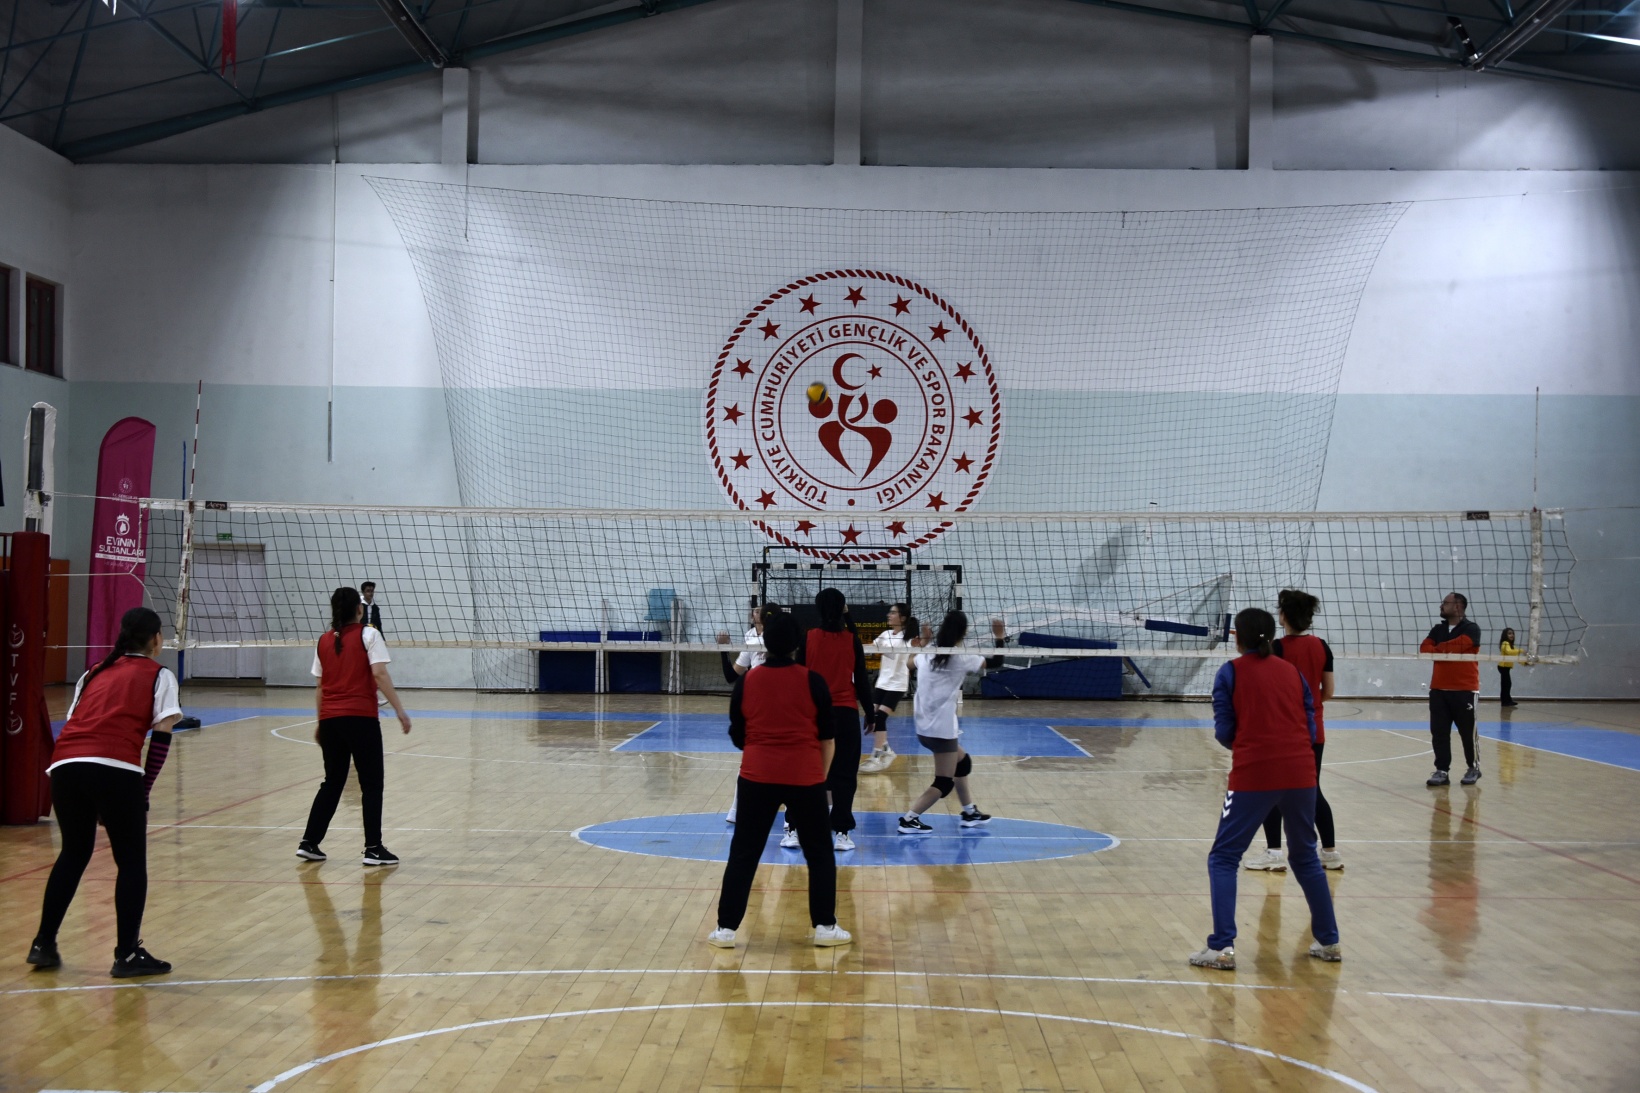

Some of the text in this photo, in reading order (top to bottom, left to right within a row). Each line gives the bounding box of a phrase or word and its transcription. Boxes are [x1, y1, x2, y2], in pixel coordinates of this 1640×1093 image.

[760, 323, 947, 505] TÜRKİYE CUMHURİYETİ GENÇLİK VE SPOR BAKANLIĞI
